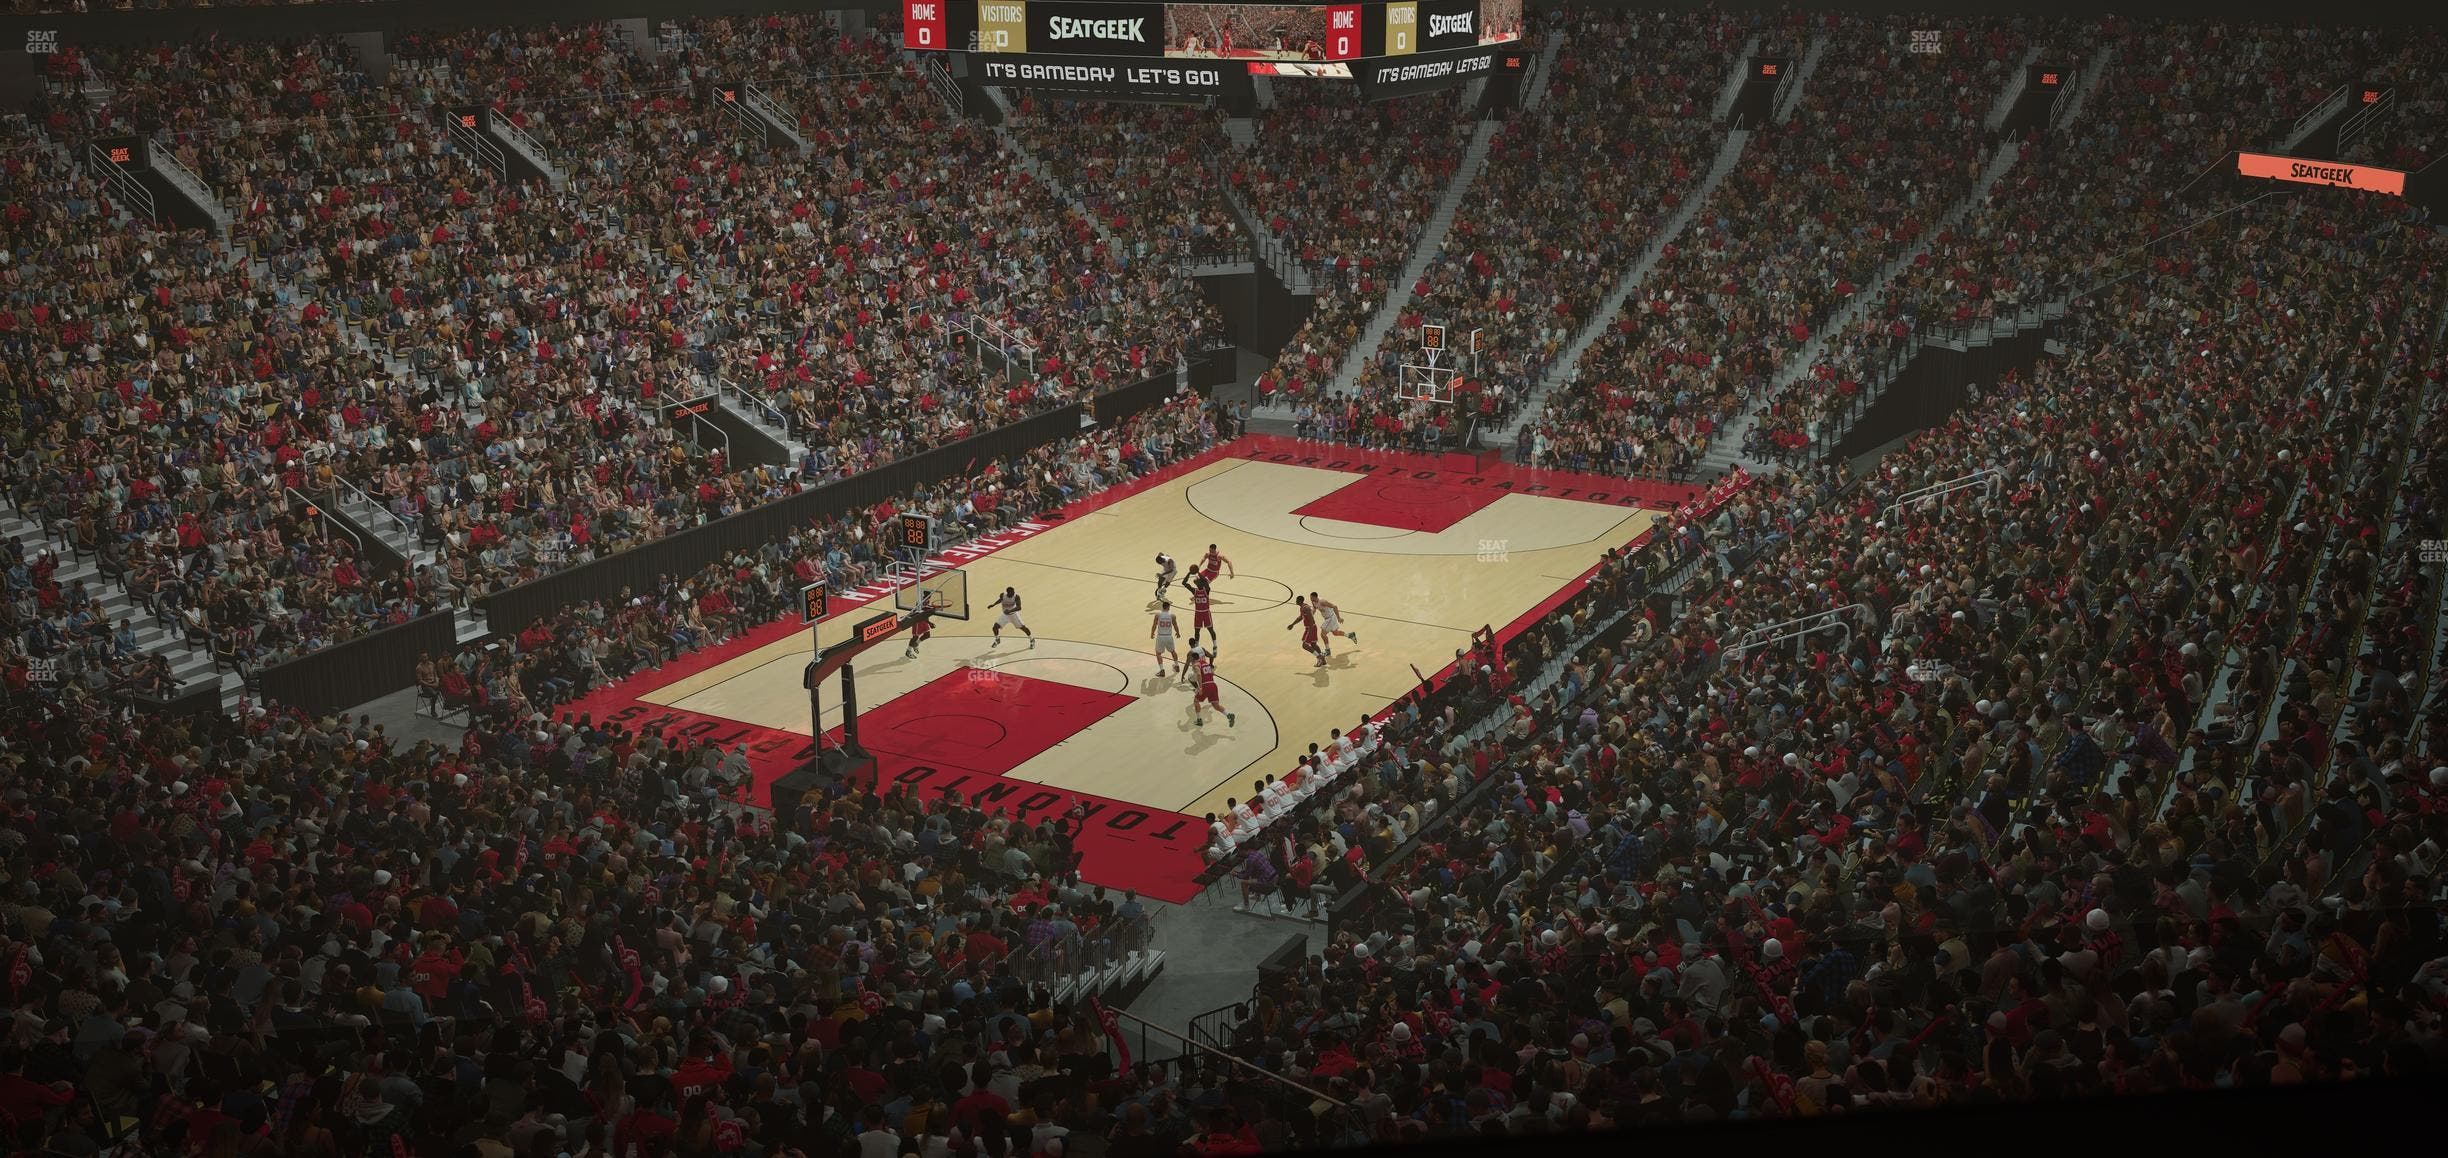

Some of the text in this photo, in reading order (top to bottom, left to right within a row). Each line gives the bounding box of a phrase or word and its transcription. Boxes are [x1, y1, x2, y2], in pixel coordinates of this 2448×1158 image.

[912, 4, 936, 21] HOME
[981, 5, 1022, 24] VISITORS
[1332, 10, 1354, 29] HOME
[1388, 6, 1415, 25] VISITORS
[1050, 15, 1145, 43] SEATGEEK
[1429, 11, 1473, 38] SEATGEEK
[918, 27, 931, 45] 0
[996, 30, 1009, 47] 0
[1337, 36, 1349, 56] 0
[1397, 32, 1406, 50] 0
[986, 62, 1220, 86] IT'S GAMEDAY LET'S GO!
[1377, 55, 1492, 84] IT'S GAMEDAY LET'S GO!
[110, 147, 129, 156] SEAT
[2290, 163, 2354, 184] SEATGEEK
[1247, 450, 1680, 509] TORONTO RAPTORS
[907, 530, 924, 545] 88
[940, 535, 1013, 560] THE
[866, 618, 894, 638] SEATGEEK
[606, 706, 1187, 841] TORONTO APTORS
